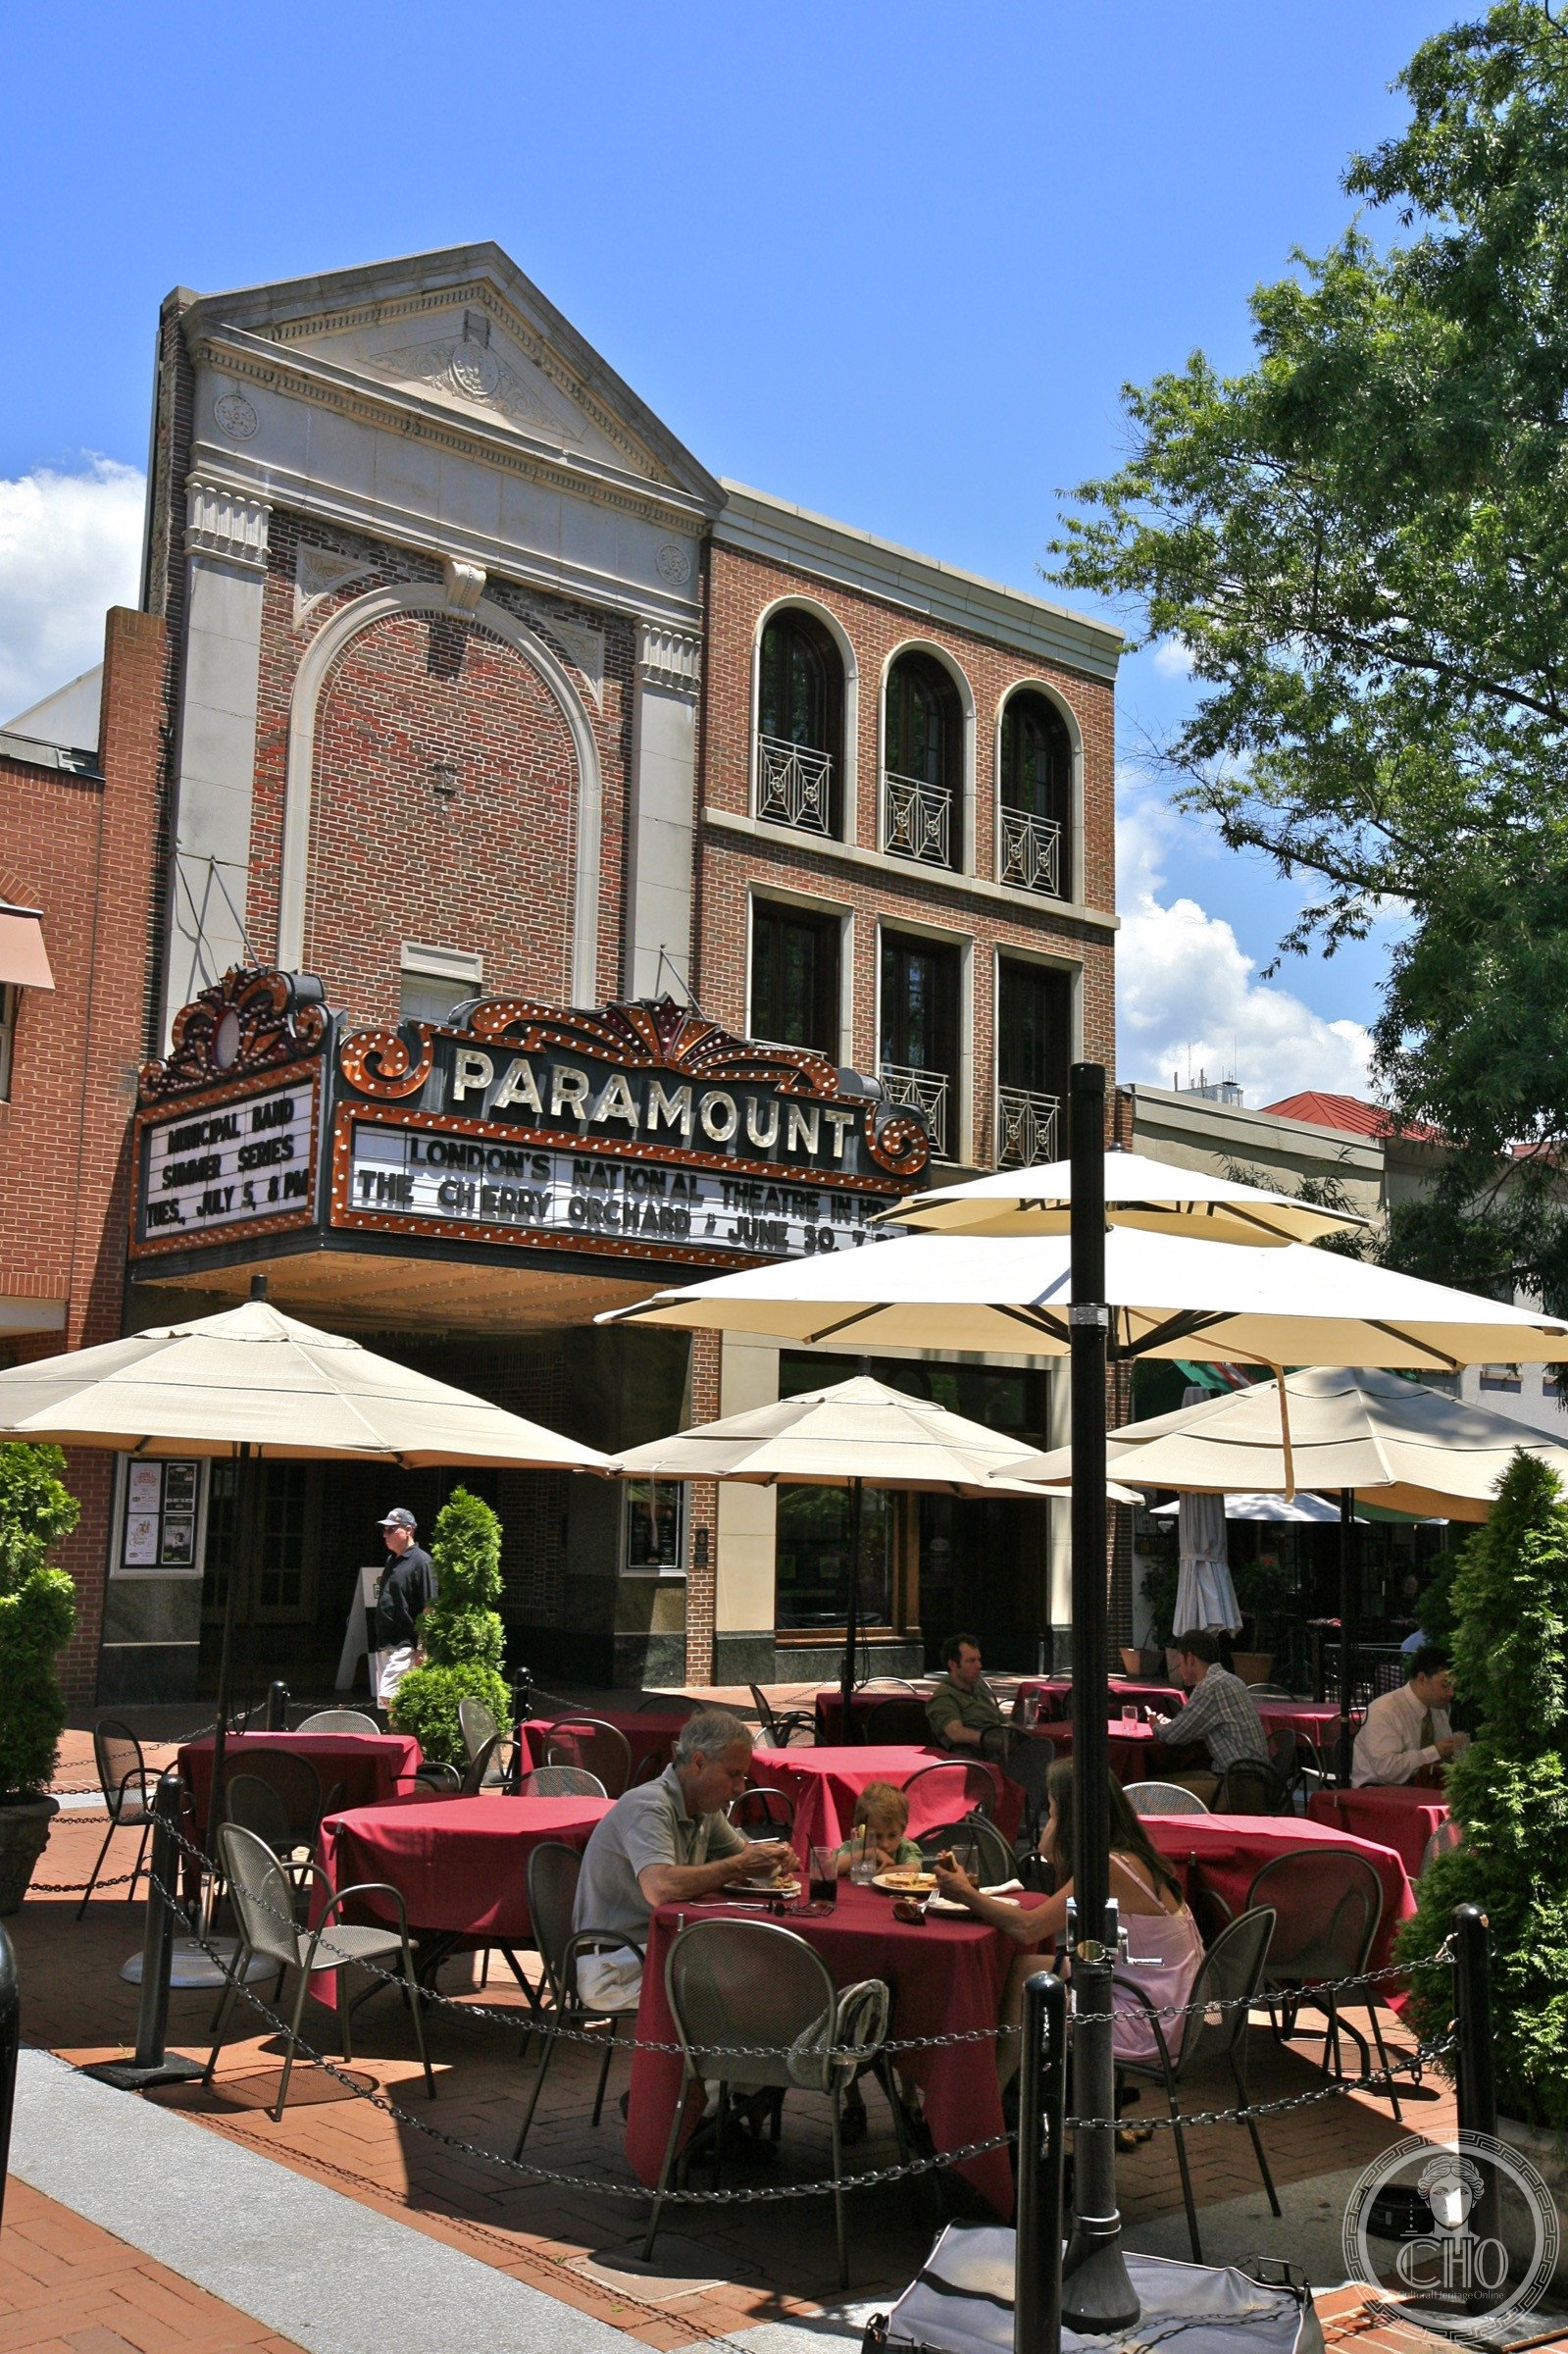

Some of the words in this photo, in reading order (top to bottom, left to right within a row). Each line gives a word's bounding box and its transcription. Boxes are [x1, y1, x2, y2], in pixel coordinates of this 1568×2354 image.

[168, 1113, 241, 1154] MUNICIPAL
[251, 1098, 294, 1133] BAND
[453, 1048, 855, 1158] PARAMOUNT
[162, 1153, 222, 1190] SUMMER
[238, 1134, 294, 1173] SERIES
[197, 1186, 235, 1217] JULY
[241, 1180, 256, 1211] 5,
[268, 1175, 279, 1203] 8
[283, 1168, 309, 1200] PM
[411, 1137, 551, 1180] LONDON'S
[574, 1158, 705, 1202] NATIONAL
[720, 1179, 821, 1220] THEATRE
[830, 1194, 852, 1220] IN
[359, 1169, 415, 1203] THE
[438, 1180, 553, 1218] CHERRY
[569, 1196, 691, 1234] ORCHARD
[729, 1215, 789, 1247] JUNE
